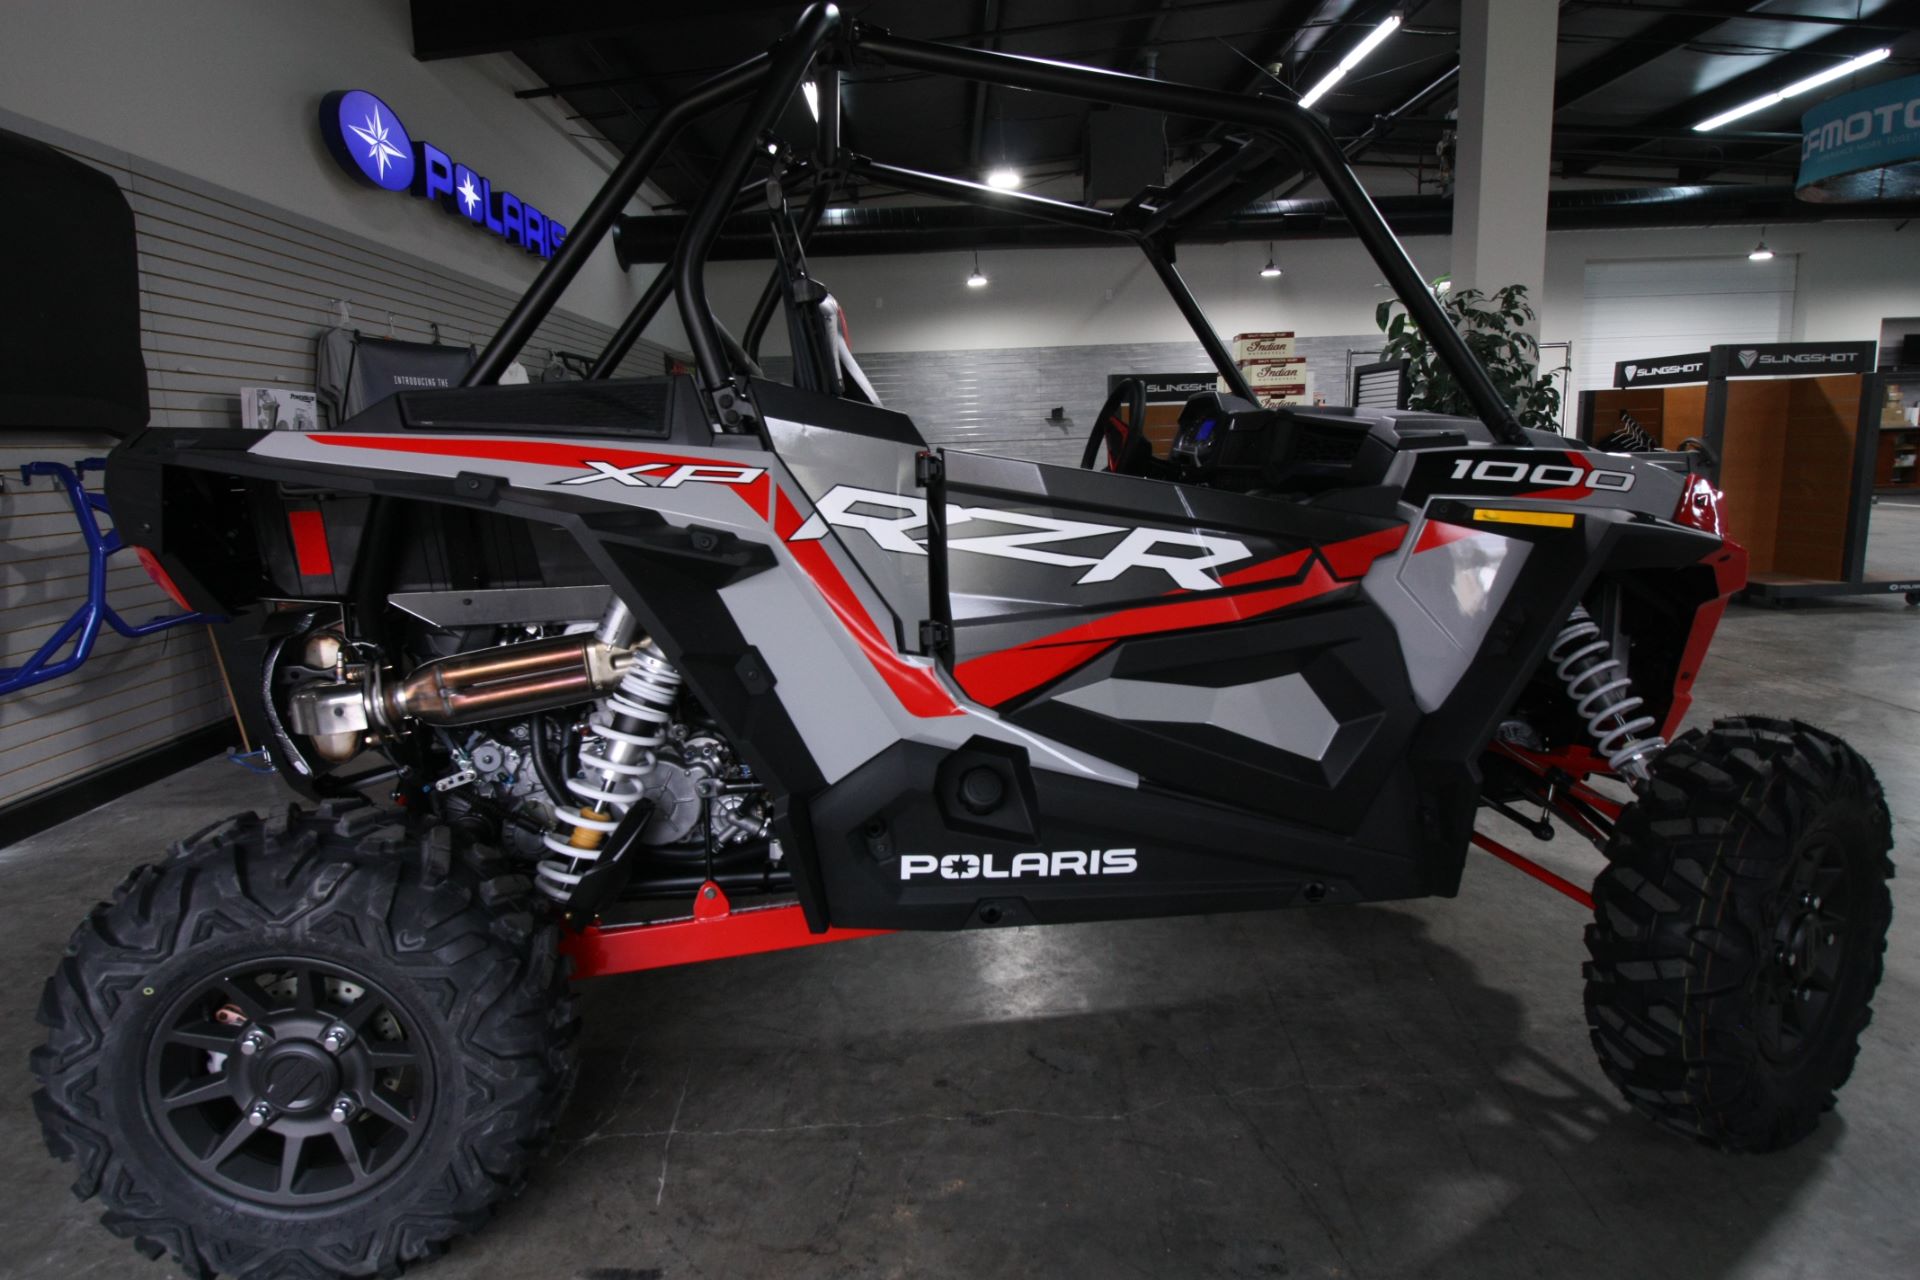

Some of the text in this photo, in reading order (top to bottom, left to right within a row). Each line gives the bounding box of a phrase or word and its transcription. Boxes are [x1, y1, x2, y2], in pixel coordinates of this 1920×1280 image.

[423, 140, 568, 260] POLARIS
[1246, 341, 1287, 352] Indian
[1758, 352, 1859, 364] SLINGSHOT
[1257, 367, 1298, 377] Indian
[1637, 363, 1703, 377] SLINGSHOT
[393, 375, 449, 388] INTRODUCING THE
[1146, 383, 1217, 392] SLINGSHO
[552, 460, 768, 488] XP
[1450, 459, 1635, 492] 1000
[788, 484, 1254, 592] RZR
[900, 848, 1138, 880] POLARIS
